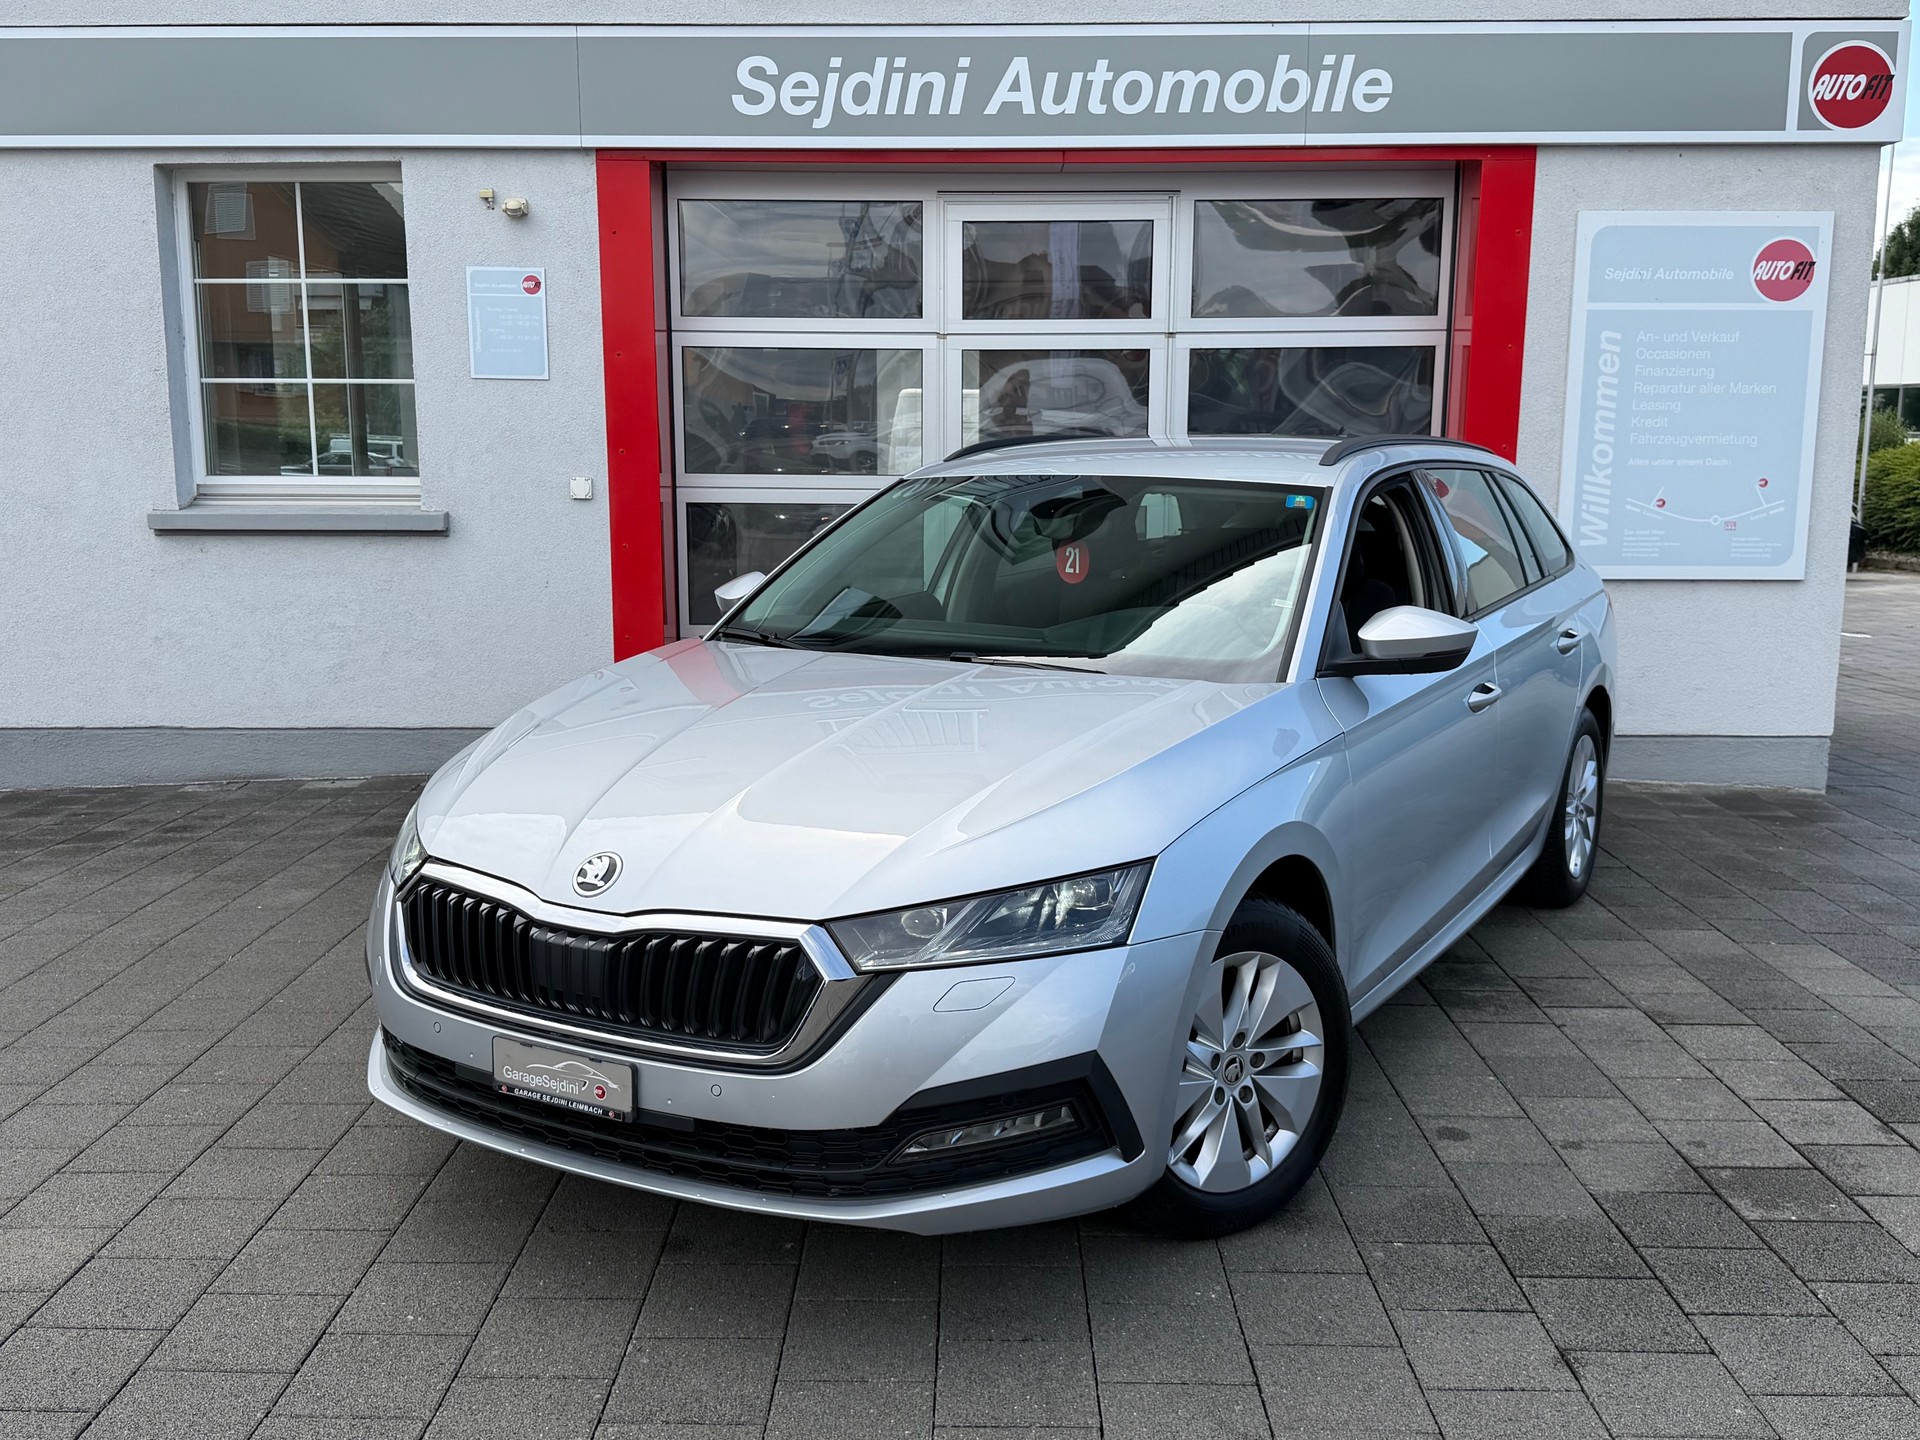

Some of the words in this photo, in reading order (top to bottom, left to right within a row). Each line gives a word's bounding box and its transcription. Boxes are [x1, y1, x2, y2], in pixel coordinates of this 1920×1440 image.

[732, 56, 970, 128] Sejdini
[983, 54, 1393, 115] Automobile
[1812, 74, 1895, 101] AUTOFIT
[1604, 267, 1651, 282] Sejdini
[1655, 268, 1734, 281] Automobile
[1753, 260, 1816, 282] AUTOFIT
[1636, 331, 1659, 343] An-
[1663, 331, 1687, 343] und
[1691, 331, 1740, 343] Verkauf
[1635, 348, 1711, 360] Occasionen
[1634, 365, 1715, 379] Finanzierung
[1633, 382, 1696, 396] Reparatur
[1699, 382, 1726, 394] aller
[1729, 382, 1777, 394] Marken
[1632, 399, 1681, 413] Leasing
[1631, 416, 1668, 428] Kredit
[1579, 329, 1622, 547] Willkommen
[1630, 433, 1758, 447] Fahrzeugvermietung
[1627, 457, 1649, 466] Alles
[1651, 458, 1675, 466] unter
[1676, 458, 1704, 466] einem
[1065, 547, 1080, 574] 21
[502, 1065, 579, 1095] GarageSejdini
[514, 1088, 541, 1100] GARAGE
[542, 1094, 568, 1107] SEJDINI
[568, 1101, 603, 1115] LEIMBACH
